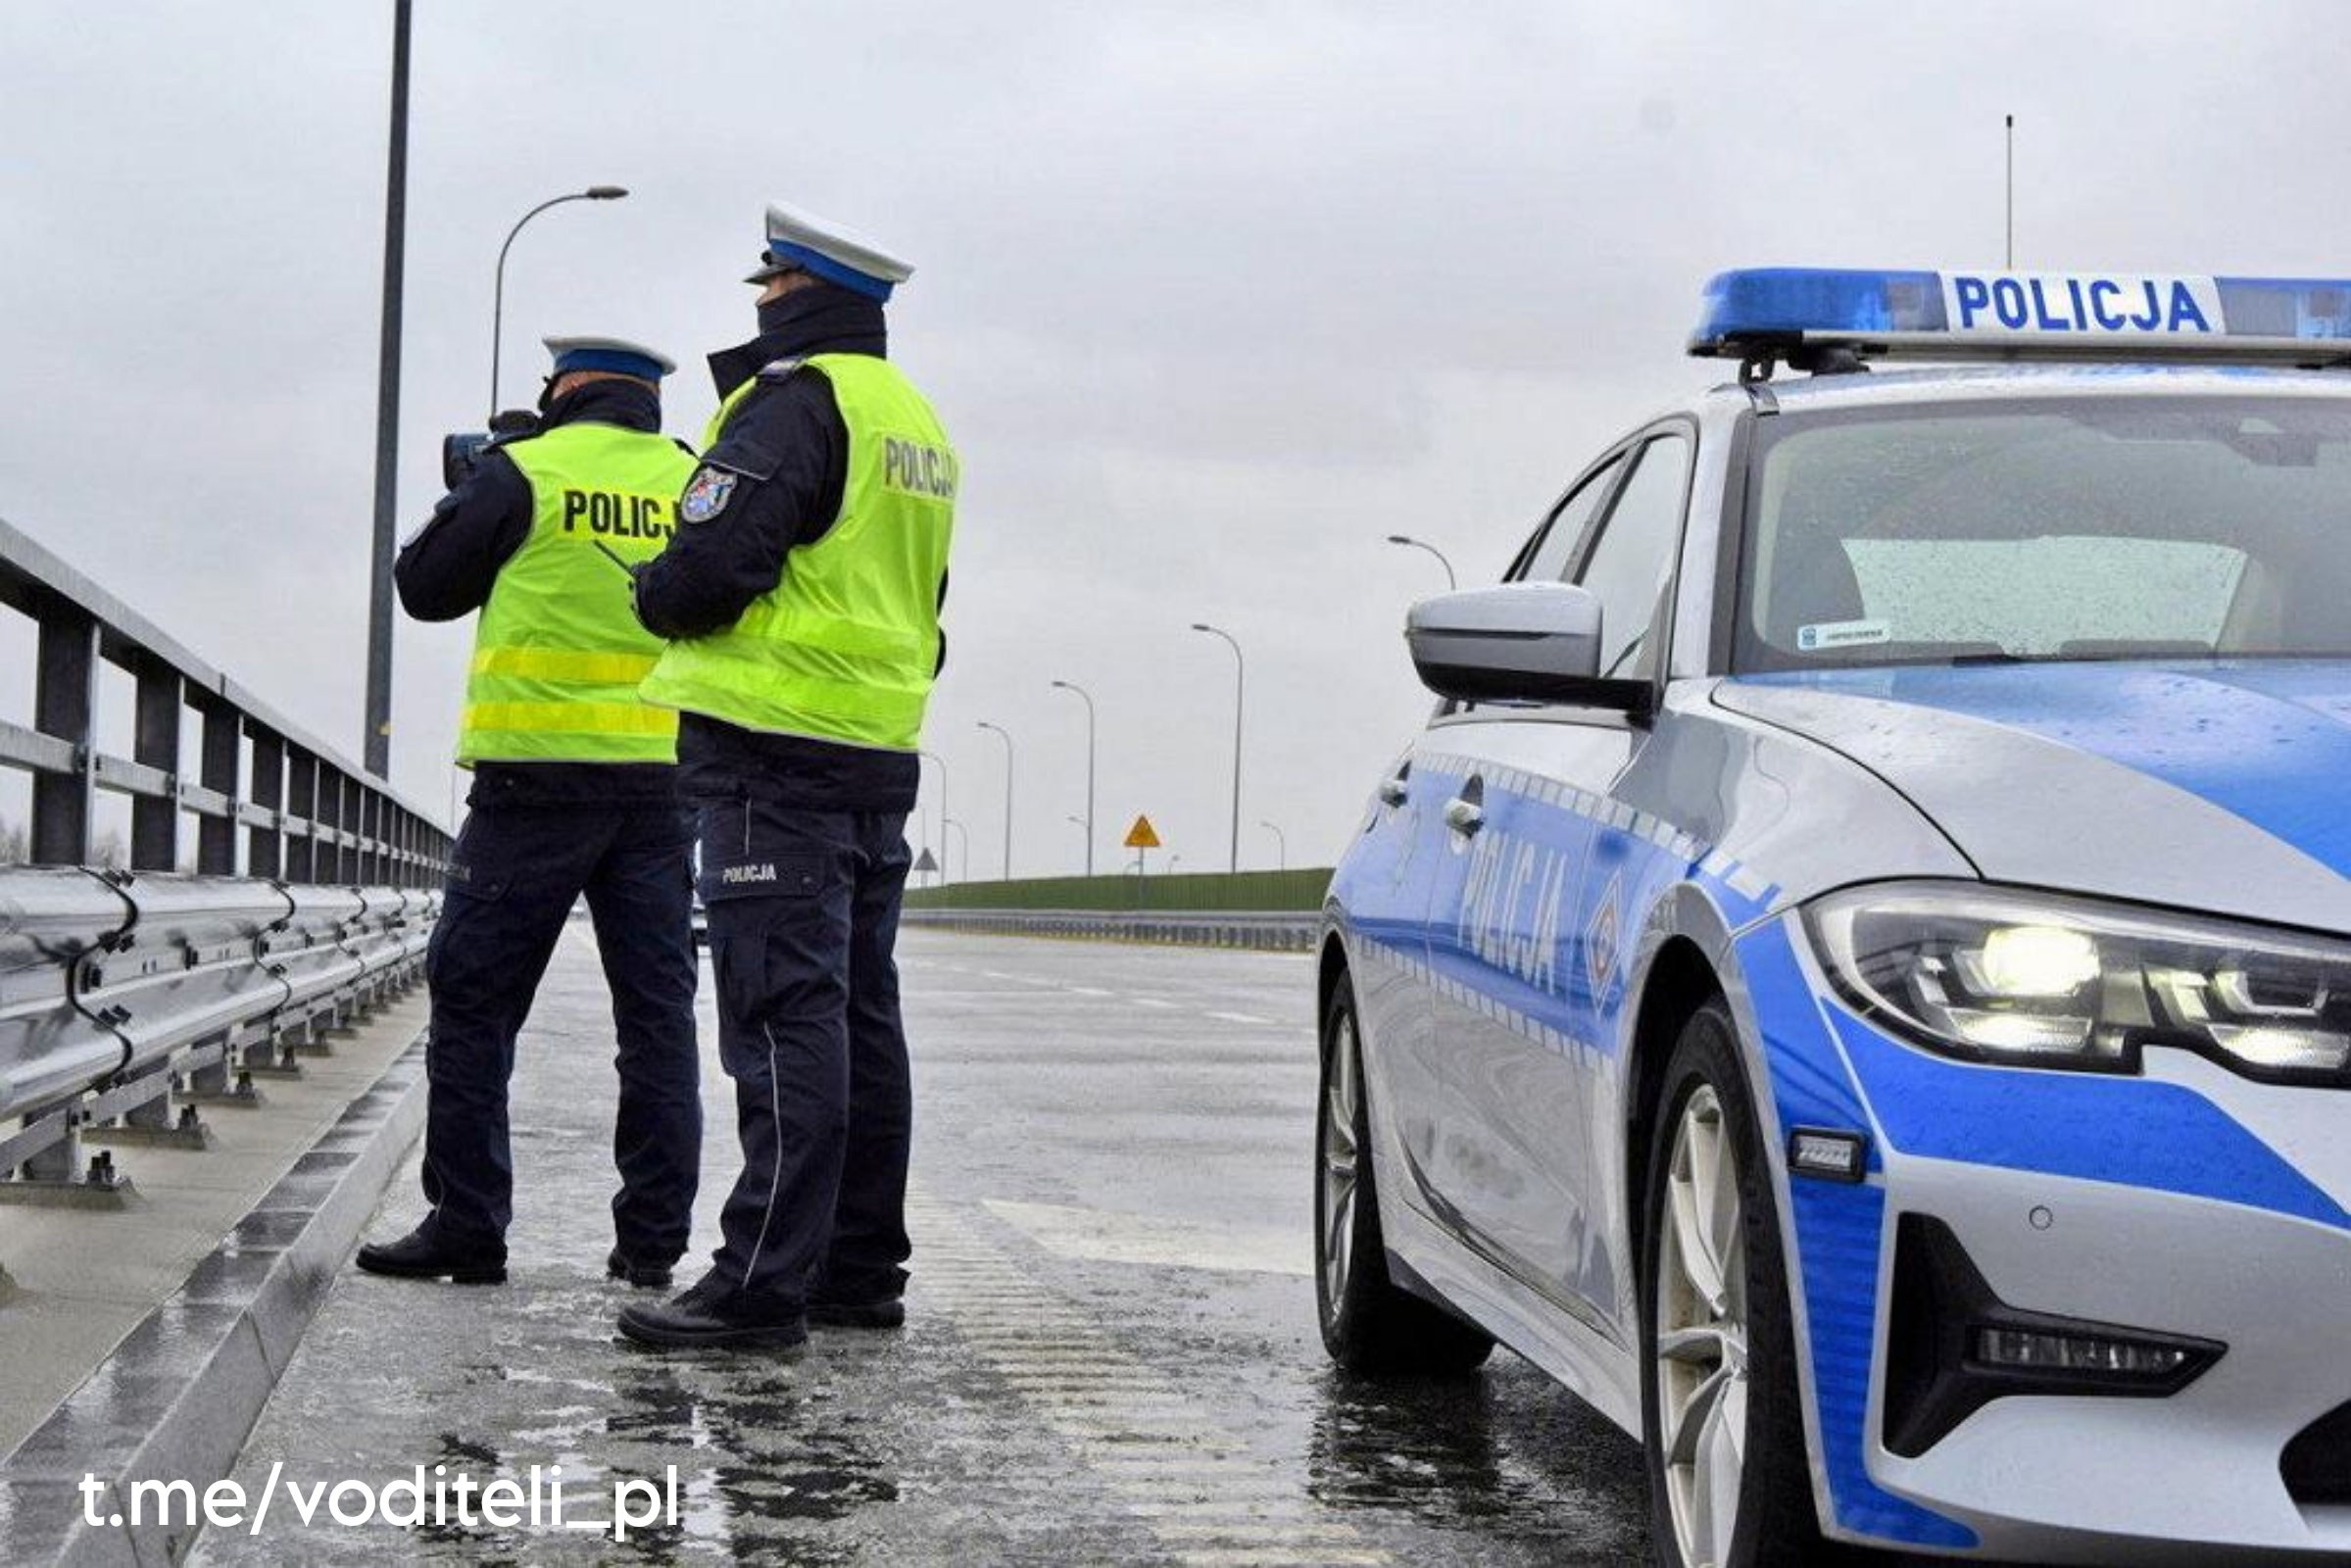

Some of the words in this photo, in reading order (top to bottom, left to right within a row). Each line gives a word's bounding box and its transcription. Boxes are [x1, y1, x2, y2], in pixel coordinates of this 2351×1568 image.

[1953, 276, 2211, 332] POLICJA
[722, 863, 777, 885] POLICJA
[1456, 827, 1567, 997] POLICJA
